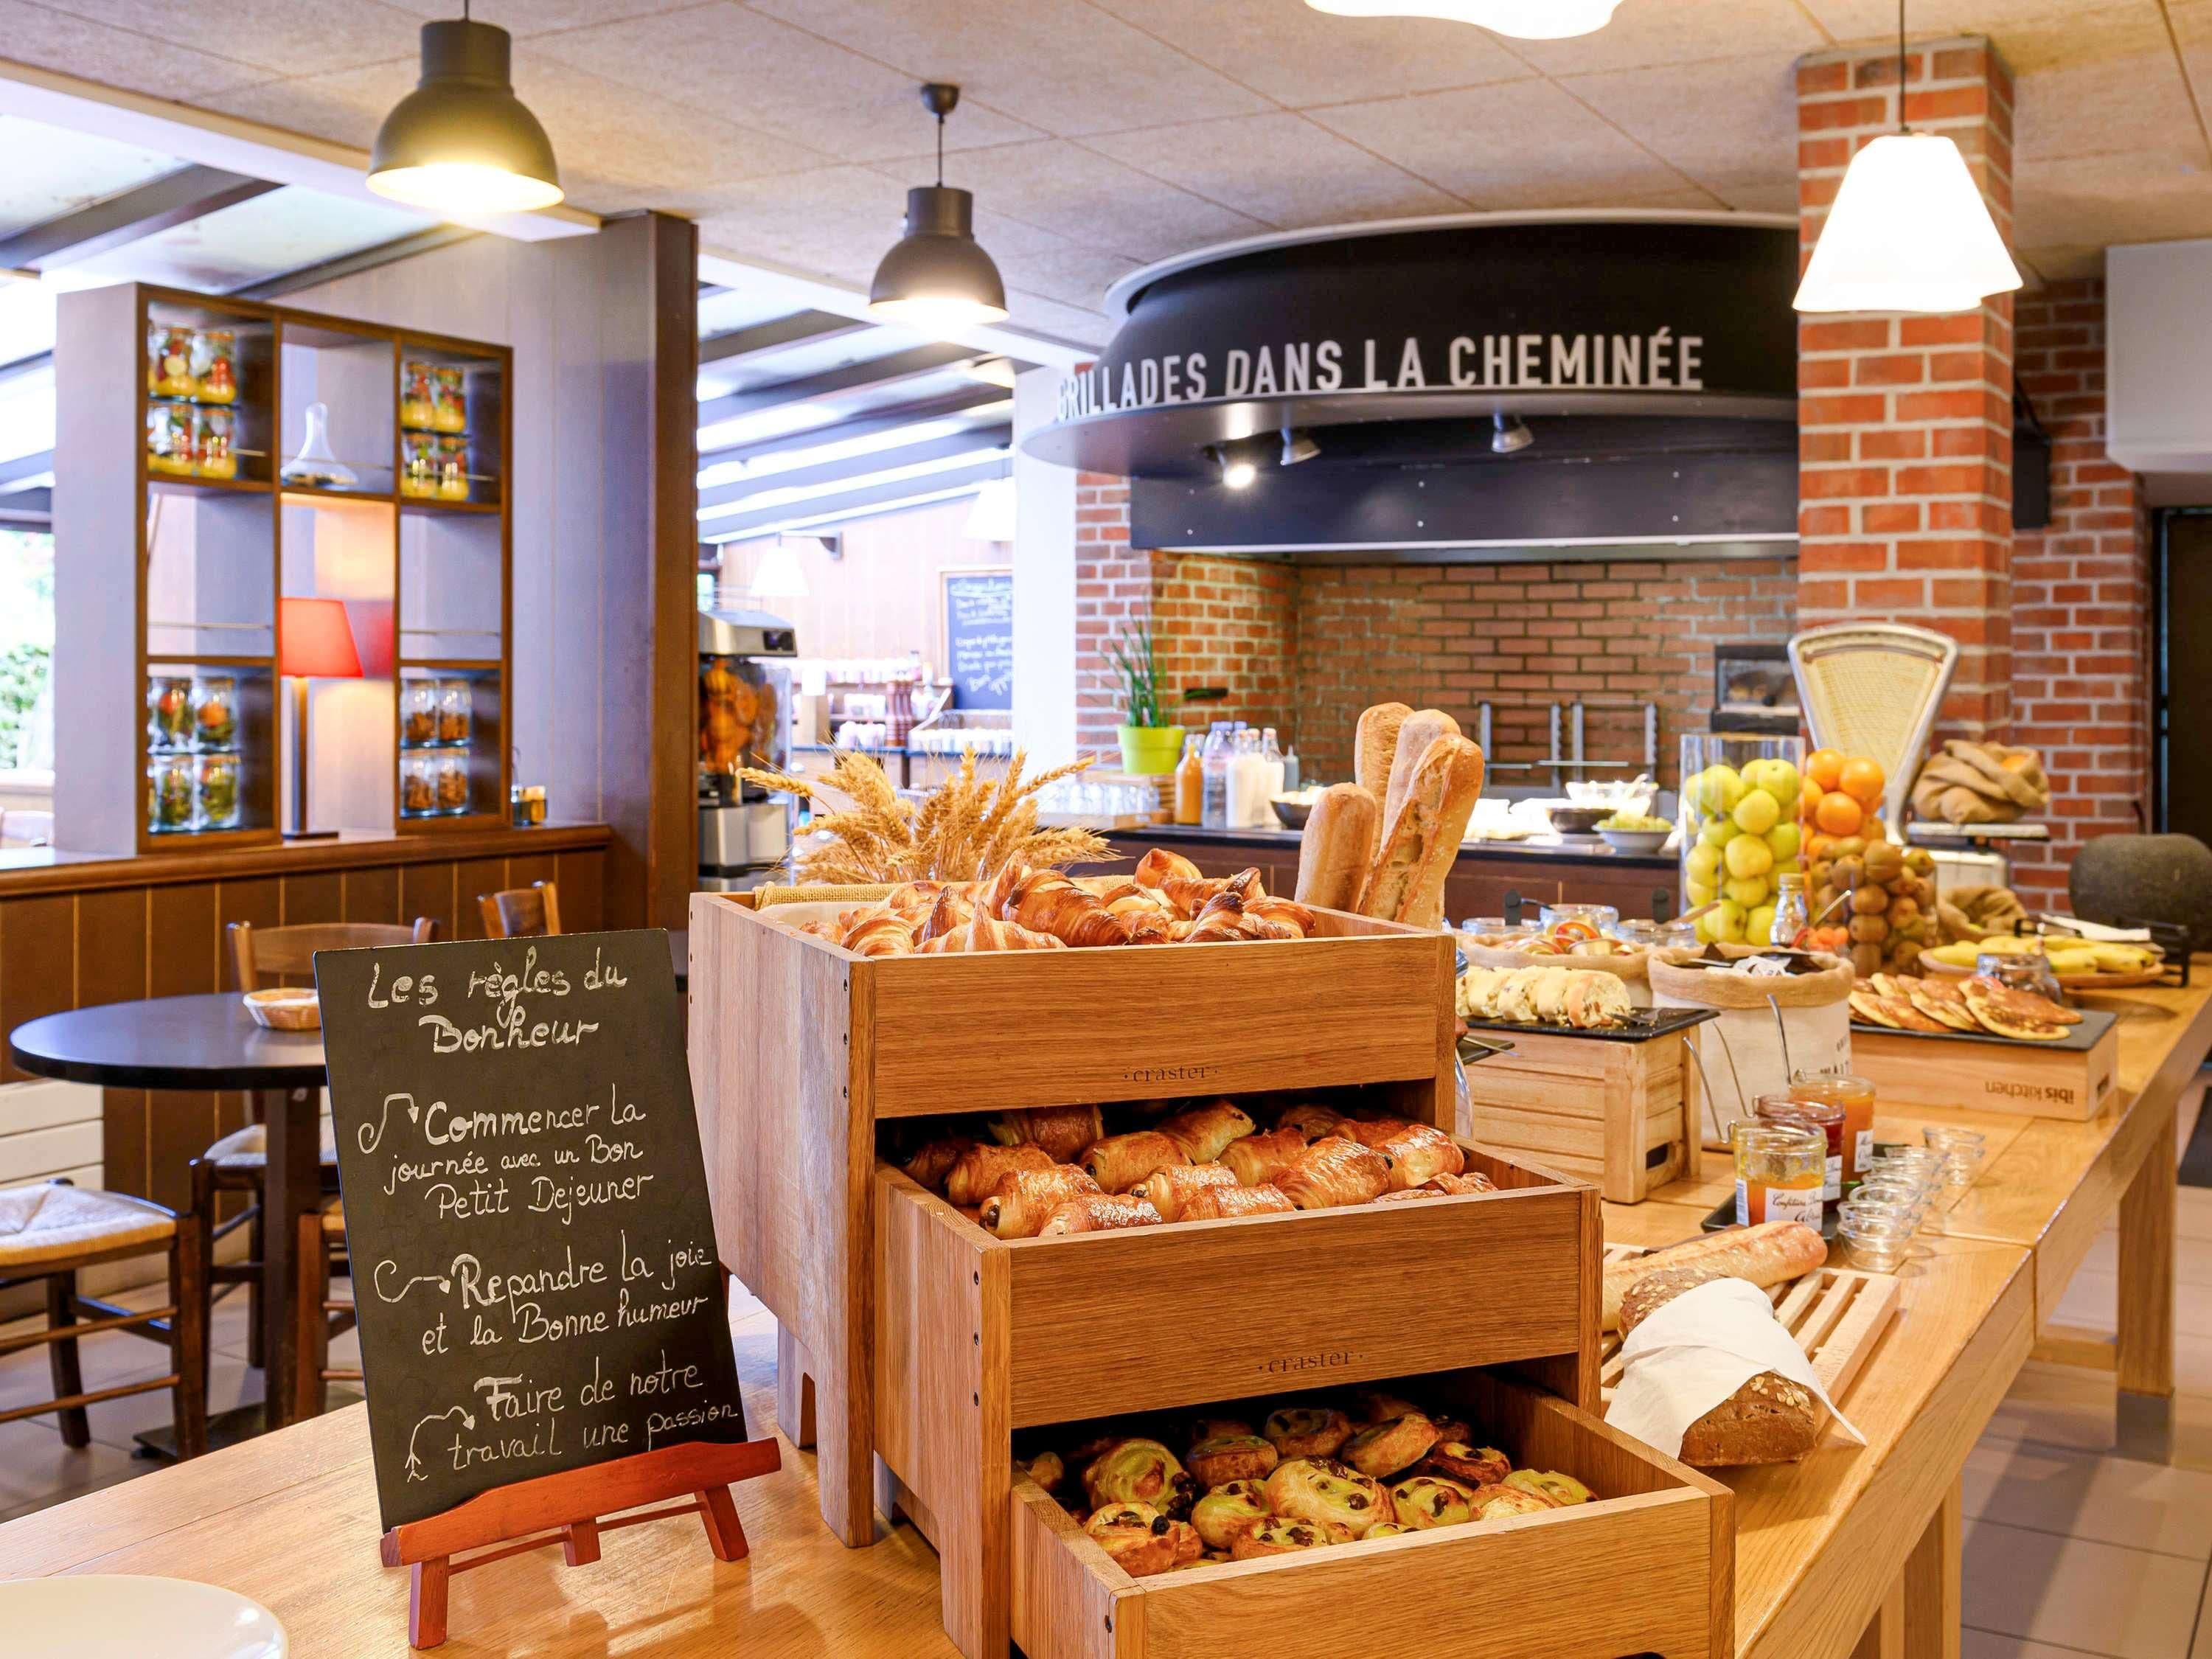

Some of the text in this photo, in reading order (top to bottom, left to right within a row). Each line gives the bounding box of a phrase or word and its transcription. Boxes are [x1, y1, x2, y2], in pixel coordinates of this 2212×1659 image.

[1224, 338, 1343, 395] DANS
[1365, 338, 1425, 389] LA
[1450, 326, 1703, 389] CHEMINÉE
[368, 946, 627, 1029] Les règles du
[419, 1013, 599, 1054] Bonheur
[424, 1102, 600, 1145] Commencer
[1985, 1080, 2075, 1105] ibis kitchen
[383, 1134, 644, 1195] journée avec un Bon
[425, 1173, 654, 1225] Petit Dejeuner
[451, 1245, 608, 1324] Repandre
[661, 1238, 712, 1290] joie
[422, 1287, 709, 1355] et la Bonne humeur
[473, 1349, 703, 1422] Faire de notre
[446, 1400, 738, 1471] travail une passion
